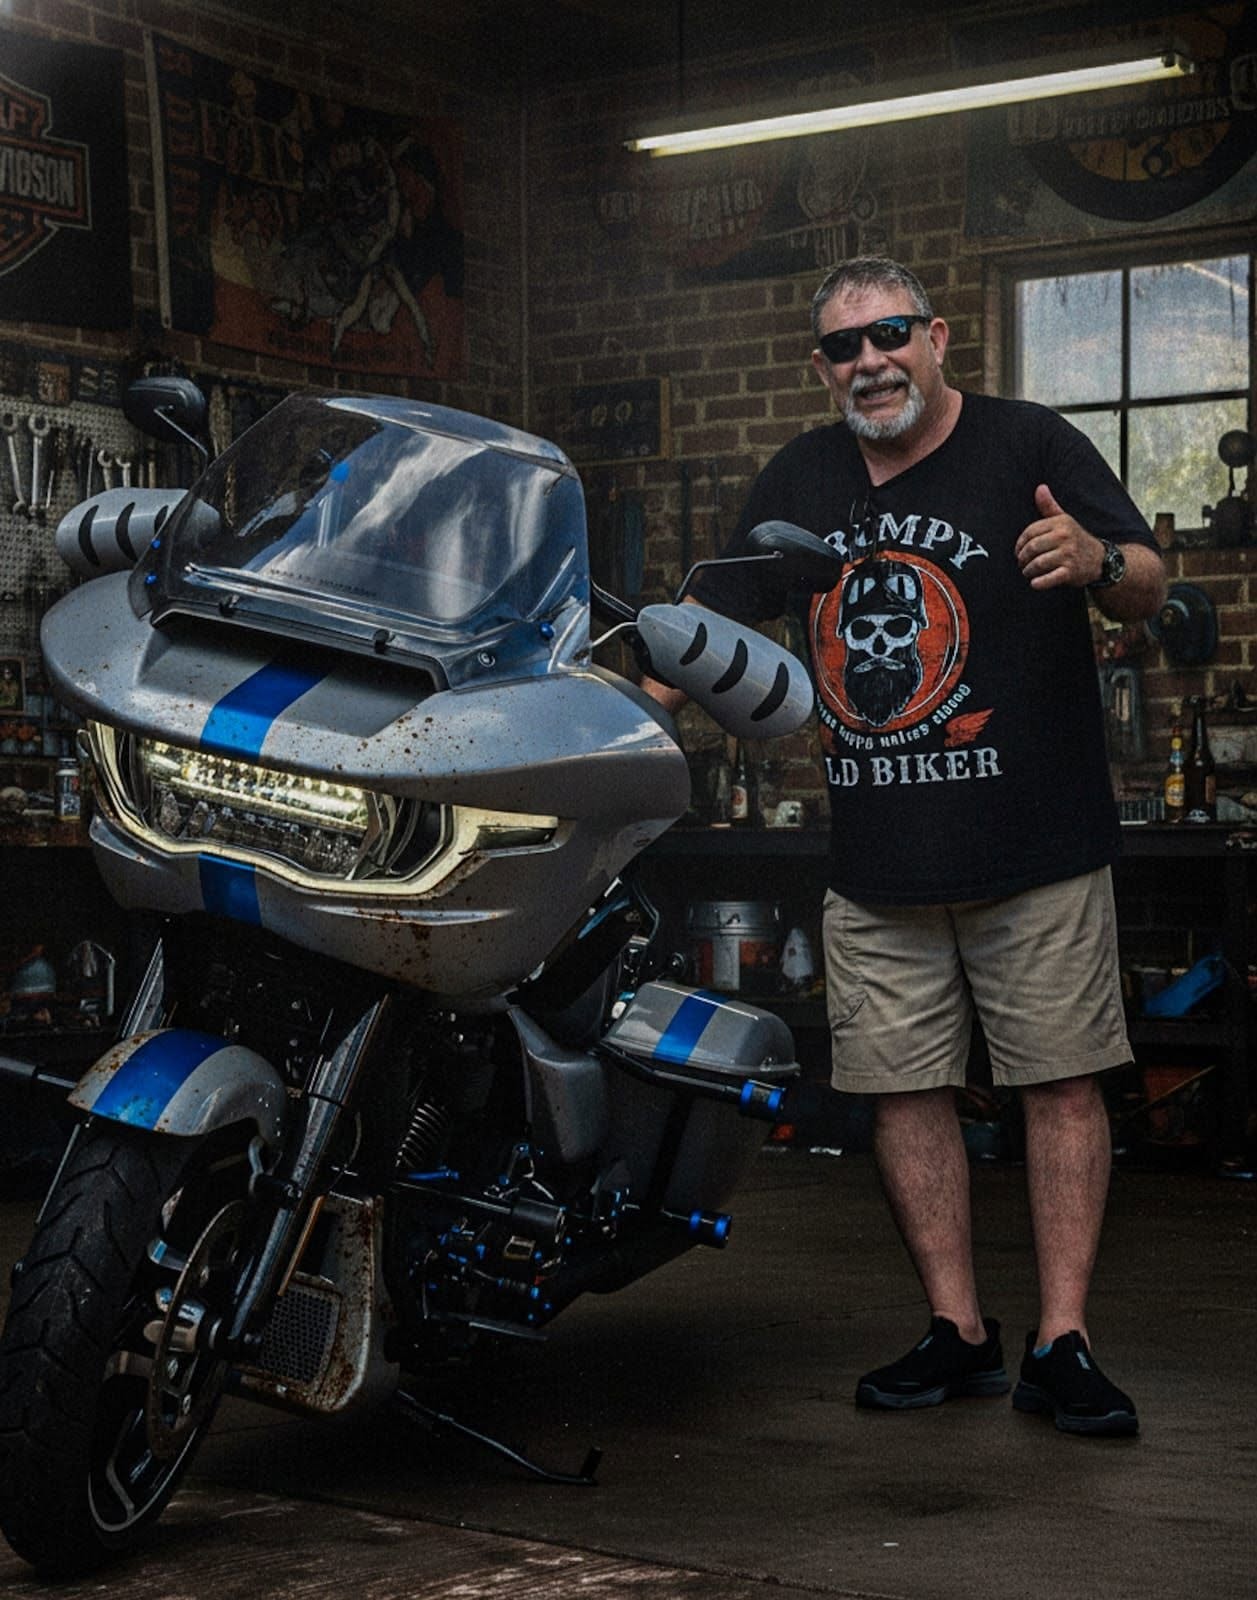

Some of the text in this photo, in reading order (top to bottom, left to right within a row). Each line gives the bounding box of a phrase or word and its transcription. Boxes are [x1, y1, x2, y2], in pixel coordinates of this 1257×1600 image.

[824, 512, 990, 570] RUMPY
[825, 746, 1003, 787] LD BIKER
